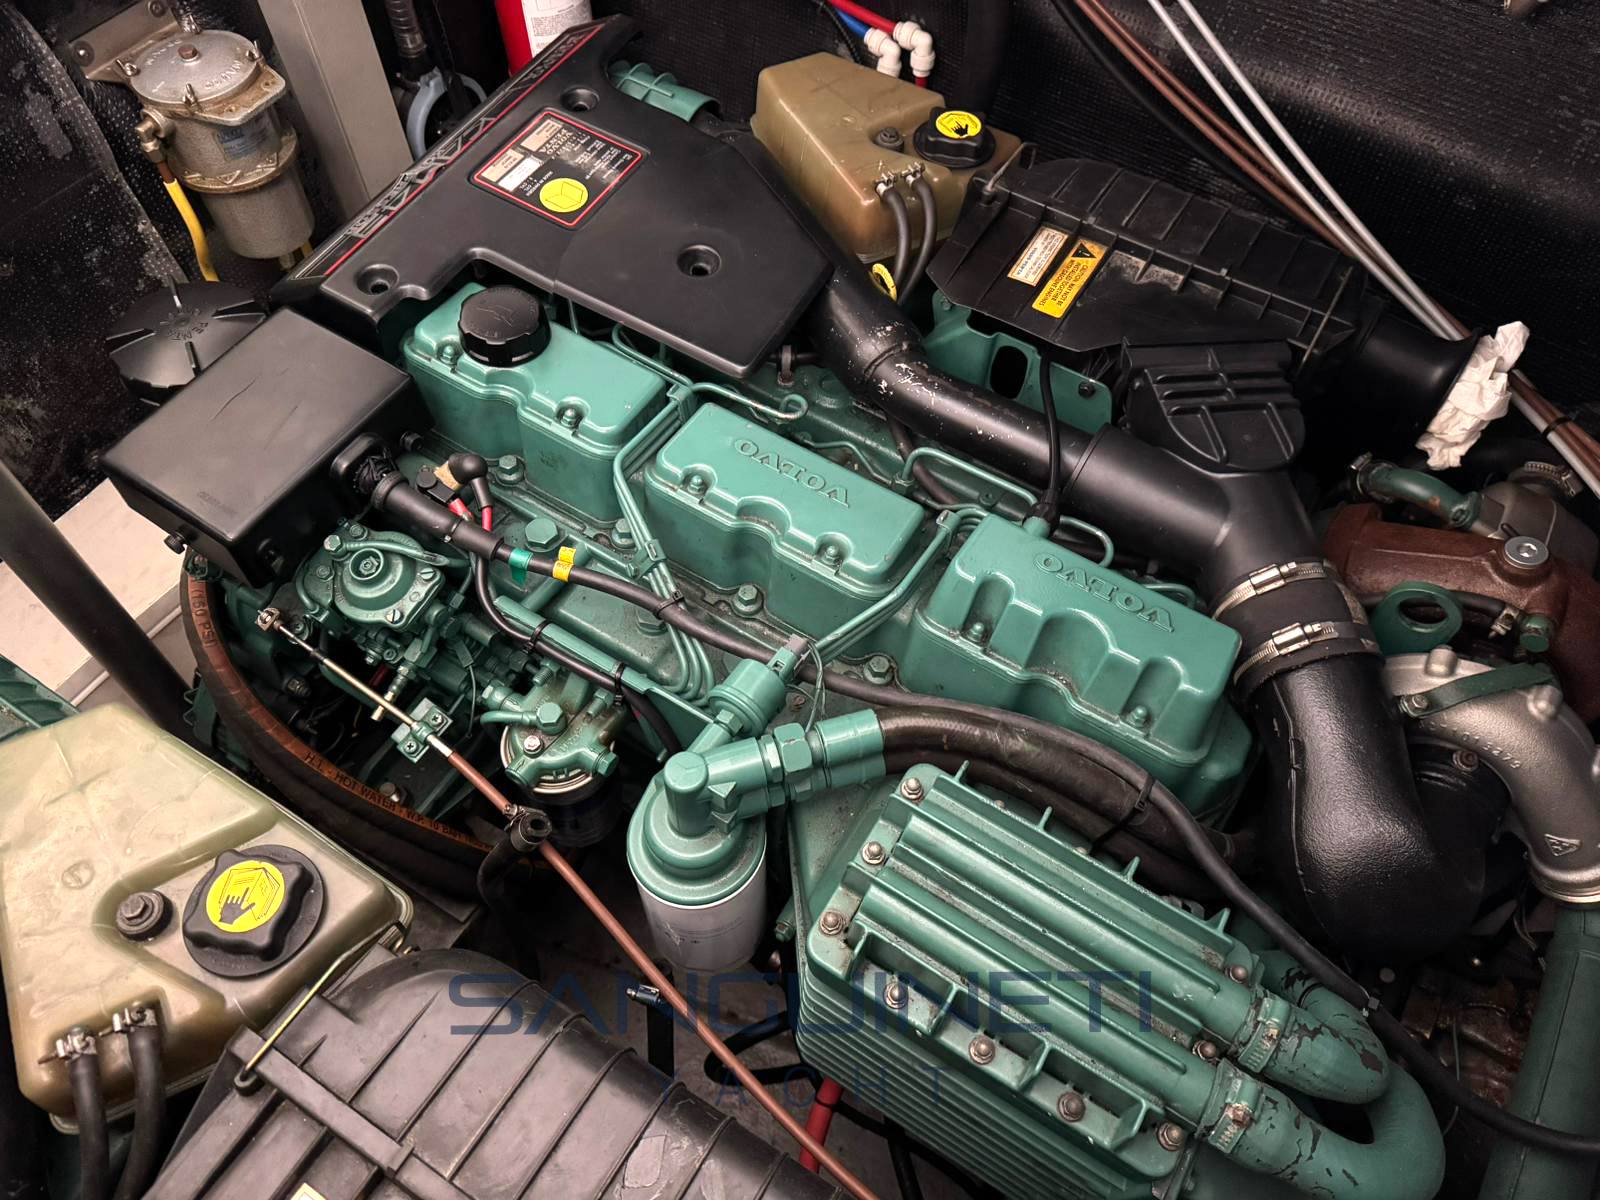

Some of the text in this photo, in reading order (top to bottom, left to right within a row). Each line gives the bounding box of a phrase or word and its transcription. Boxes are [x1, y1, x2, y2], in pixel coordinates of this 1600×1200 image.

[538, 128, 569, 155] PENTA
[545, 131, 575, 156] VOLVO
[734, 438, 850, 509] VOLVO
[1032, 551, 1175, 633] VOLVO
[335, 769, 358, 790] HOT
[361, 783, 397, 813] WATER
